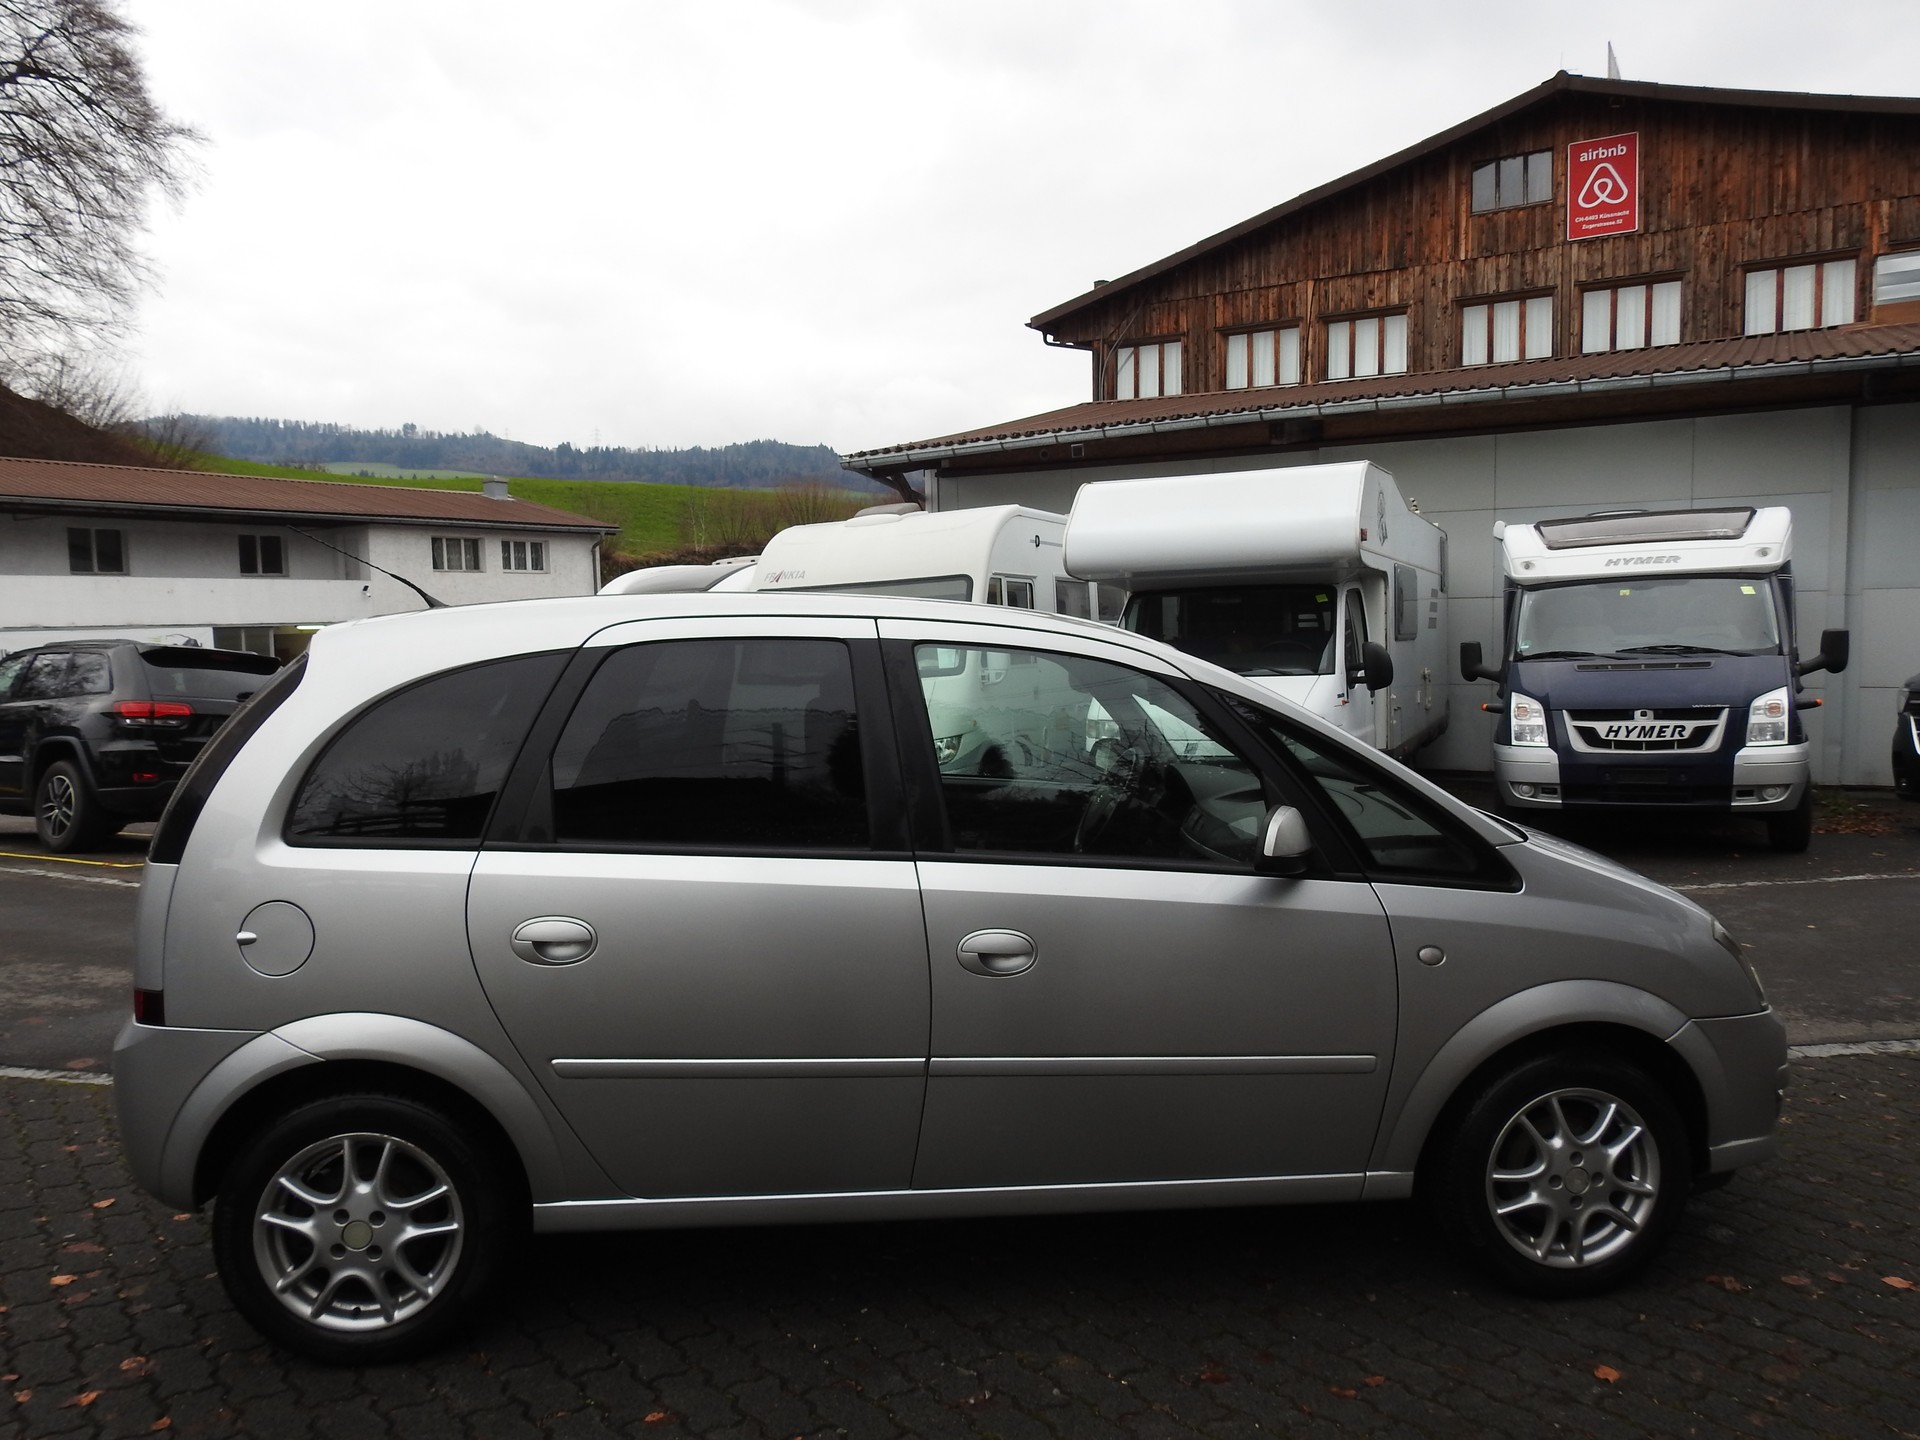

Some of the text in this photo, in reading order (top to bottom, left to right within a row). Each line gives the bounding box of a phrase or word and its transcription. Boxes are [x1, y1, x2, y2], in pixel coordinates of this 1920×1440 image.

[1579, 144, 1627, 161] airbnb
[1605, 555, 1682, 567] HYMER
[764, 570, 806, 584] FRANKIA
[1605, 725, 1686, 739] HYMER
